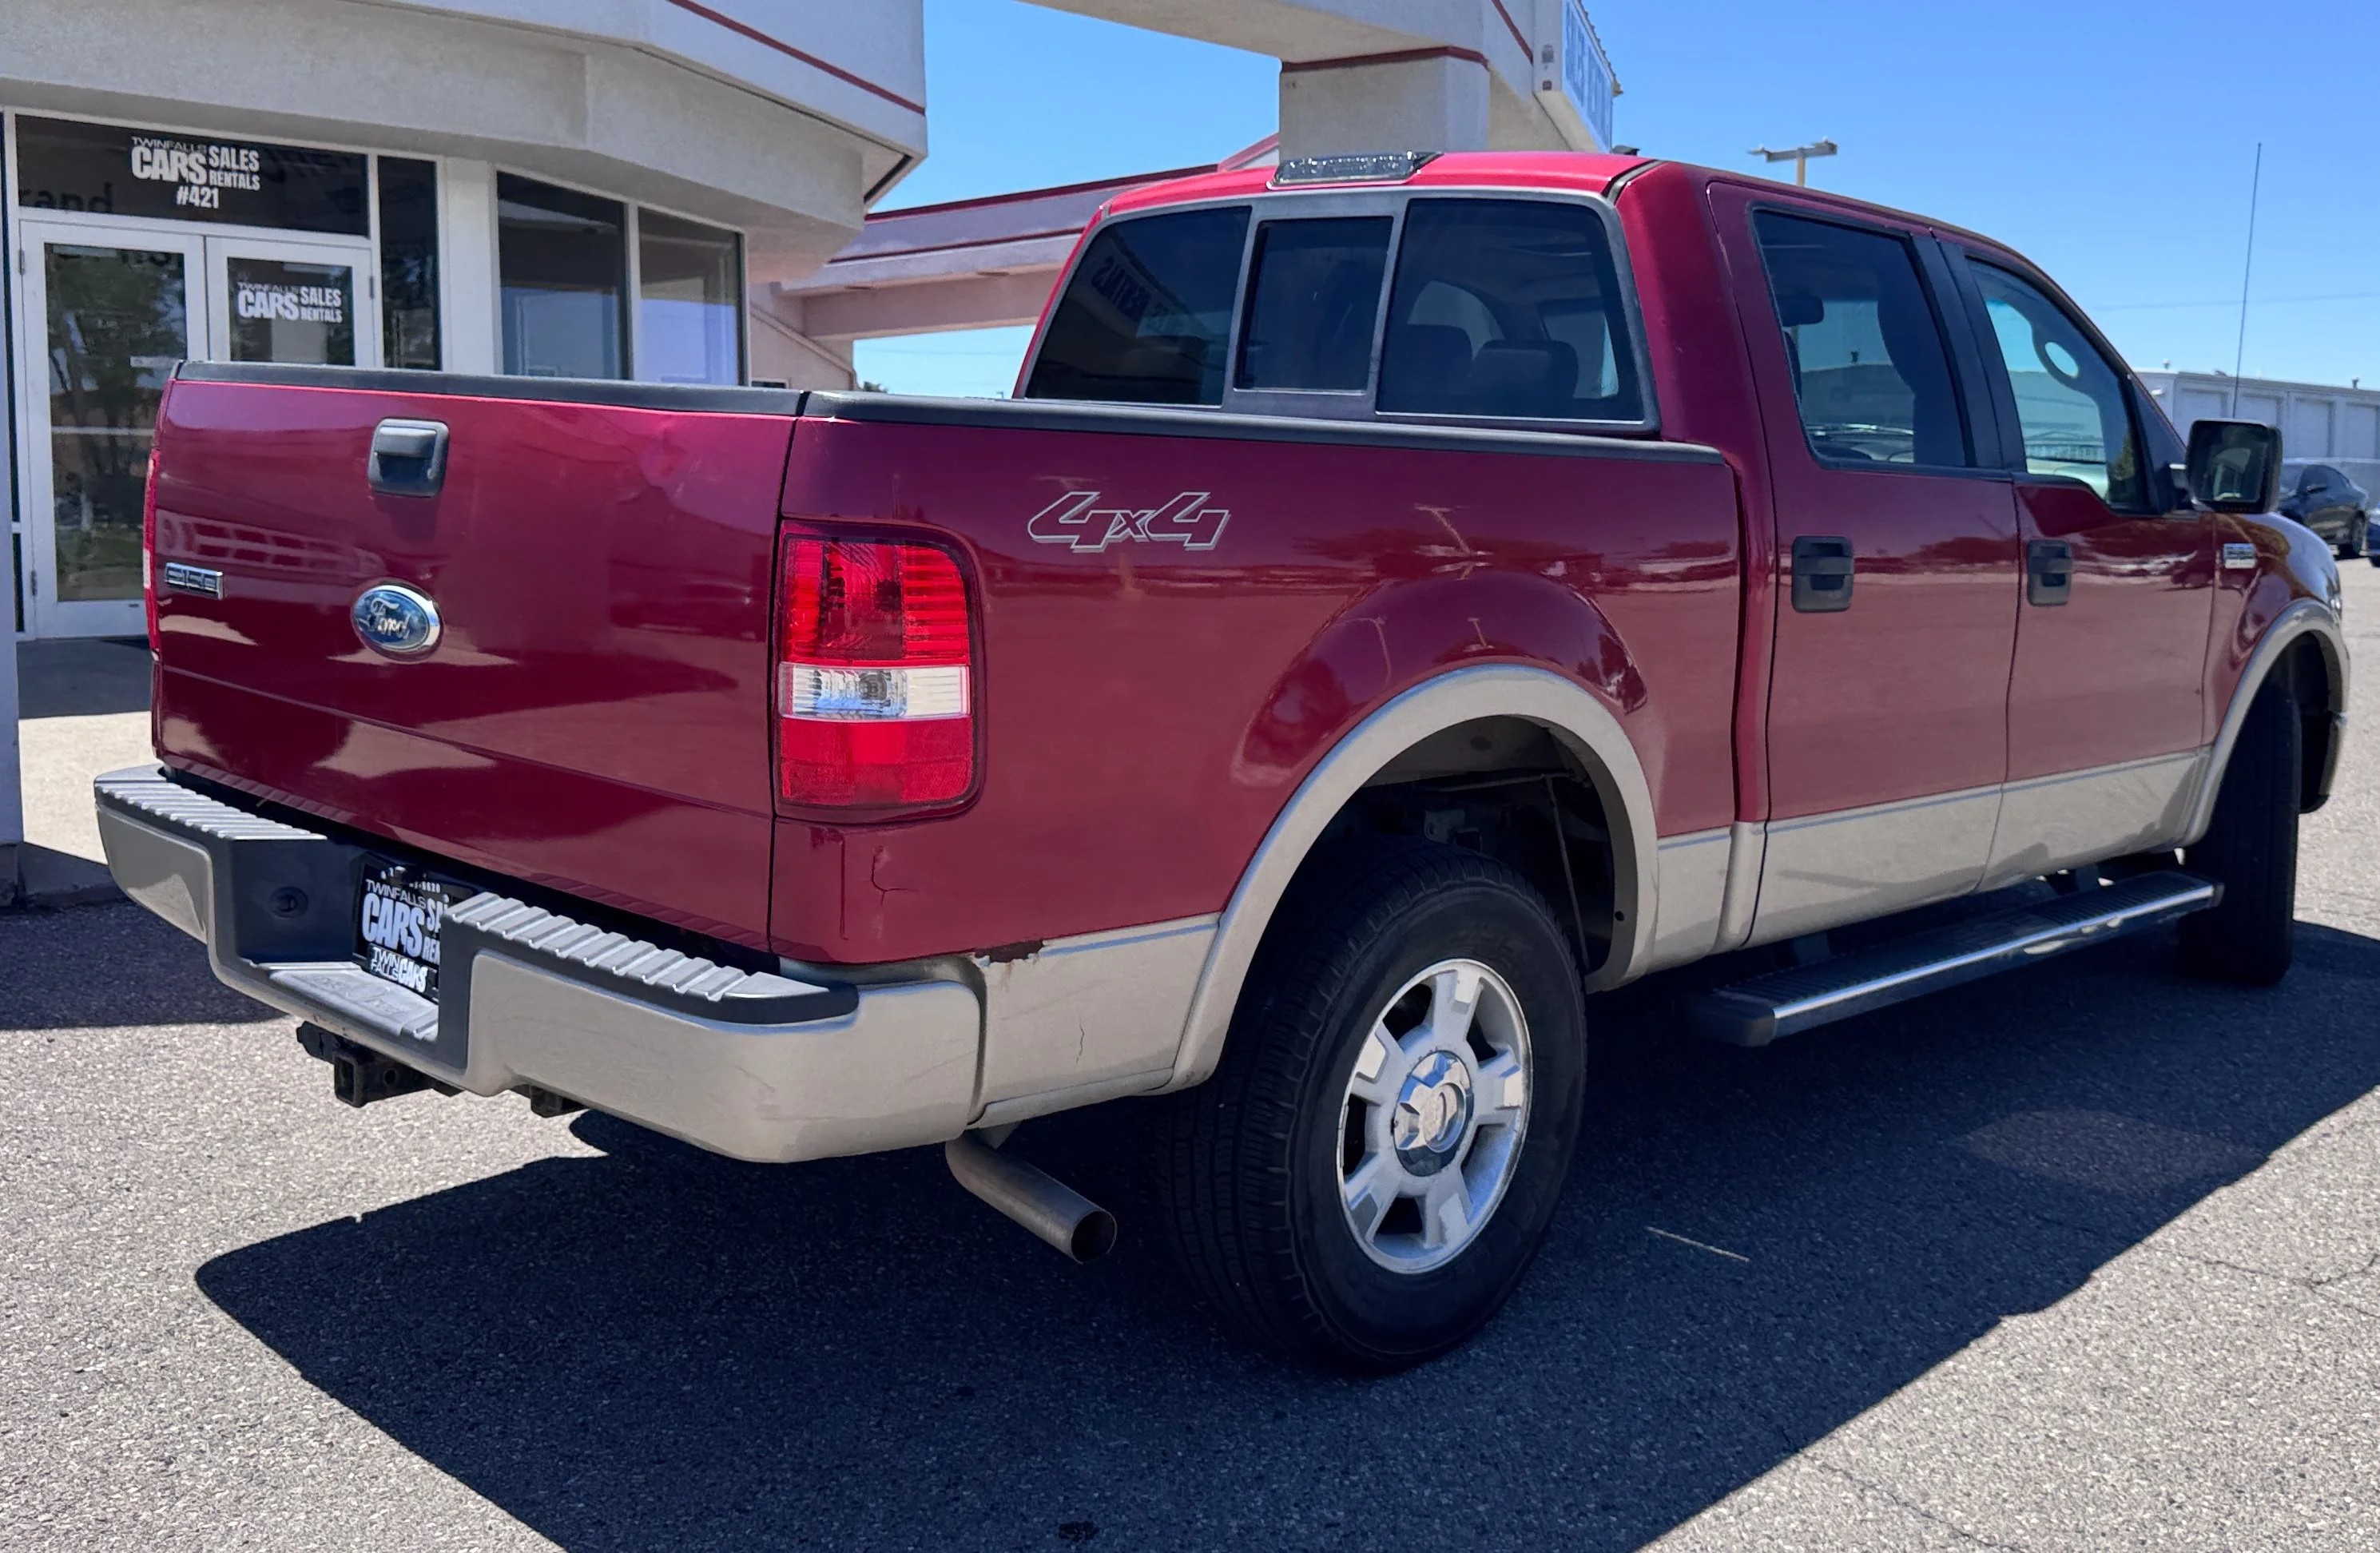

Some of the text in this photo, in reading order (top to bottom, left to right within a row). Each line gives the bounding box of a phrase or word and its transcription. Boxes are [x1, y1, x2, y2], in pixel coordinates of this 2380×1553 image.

[131, 145, 208, 185] CARS
[208, 145, 260, 173] SALES
[209, 169, 260, 191] RENTALS
[176, 185, 220, 209] #421
[238, 290, 300, 320] CARS
[300, 286, 342, 308] SALES
[300, 306, 343, 324] RENTALS
[1027, 491, 1231, 554] 4x4
[357, 598, 411, 639] Ford
[366, 879, 427, 910] TWINFALLS
[362, 892, 425, 957] CARS
[398, 959, 428, 993] CARS
